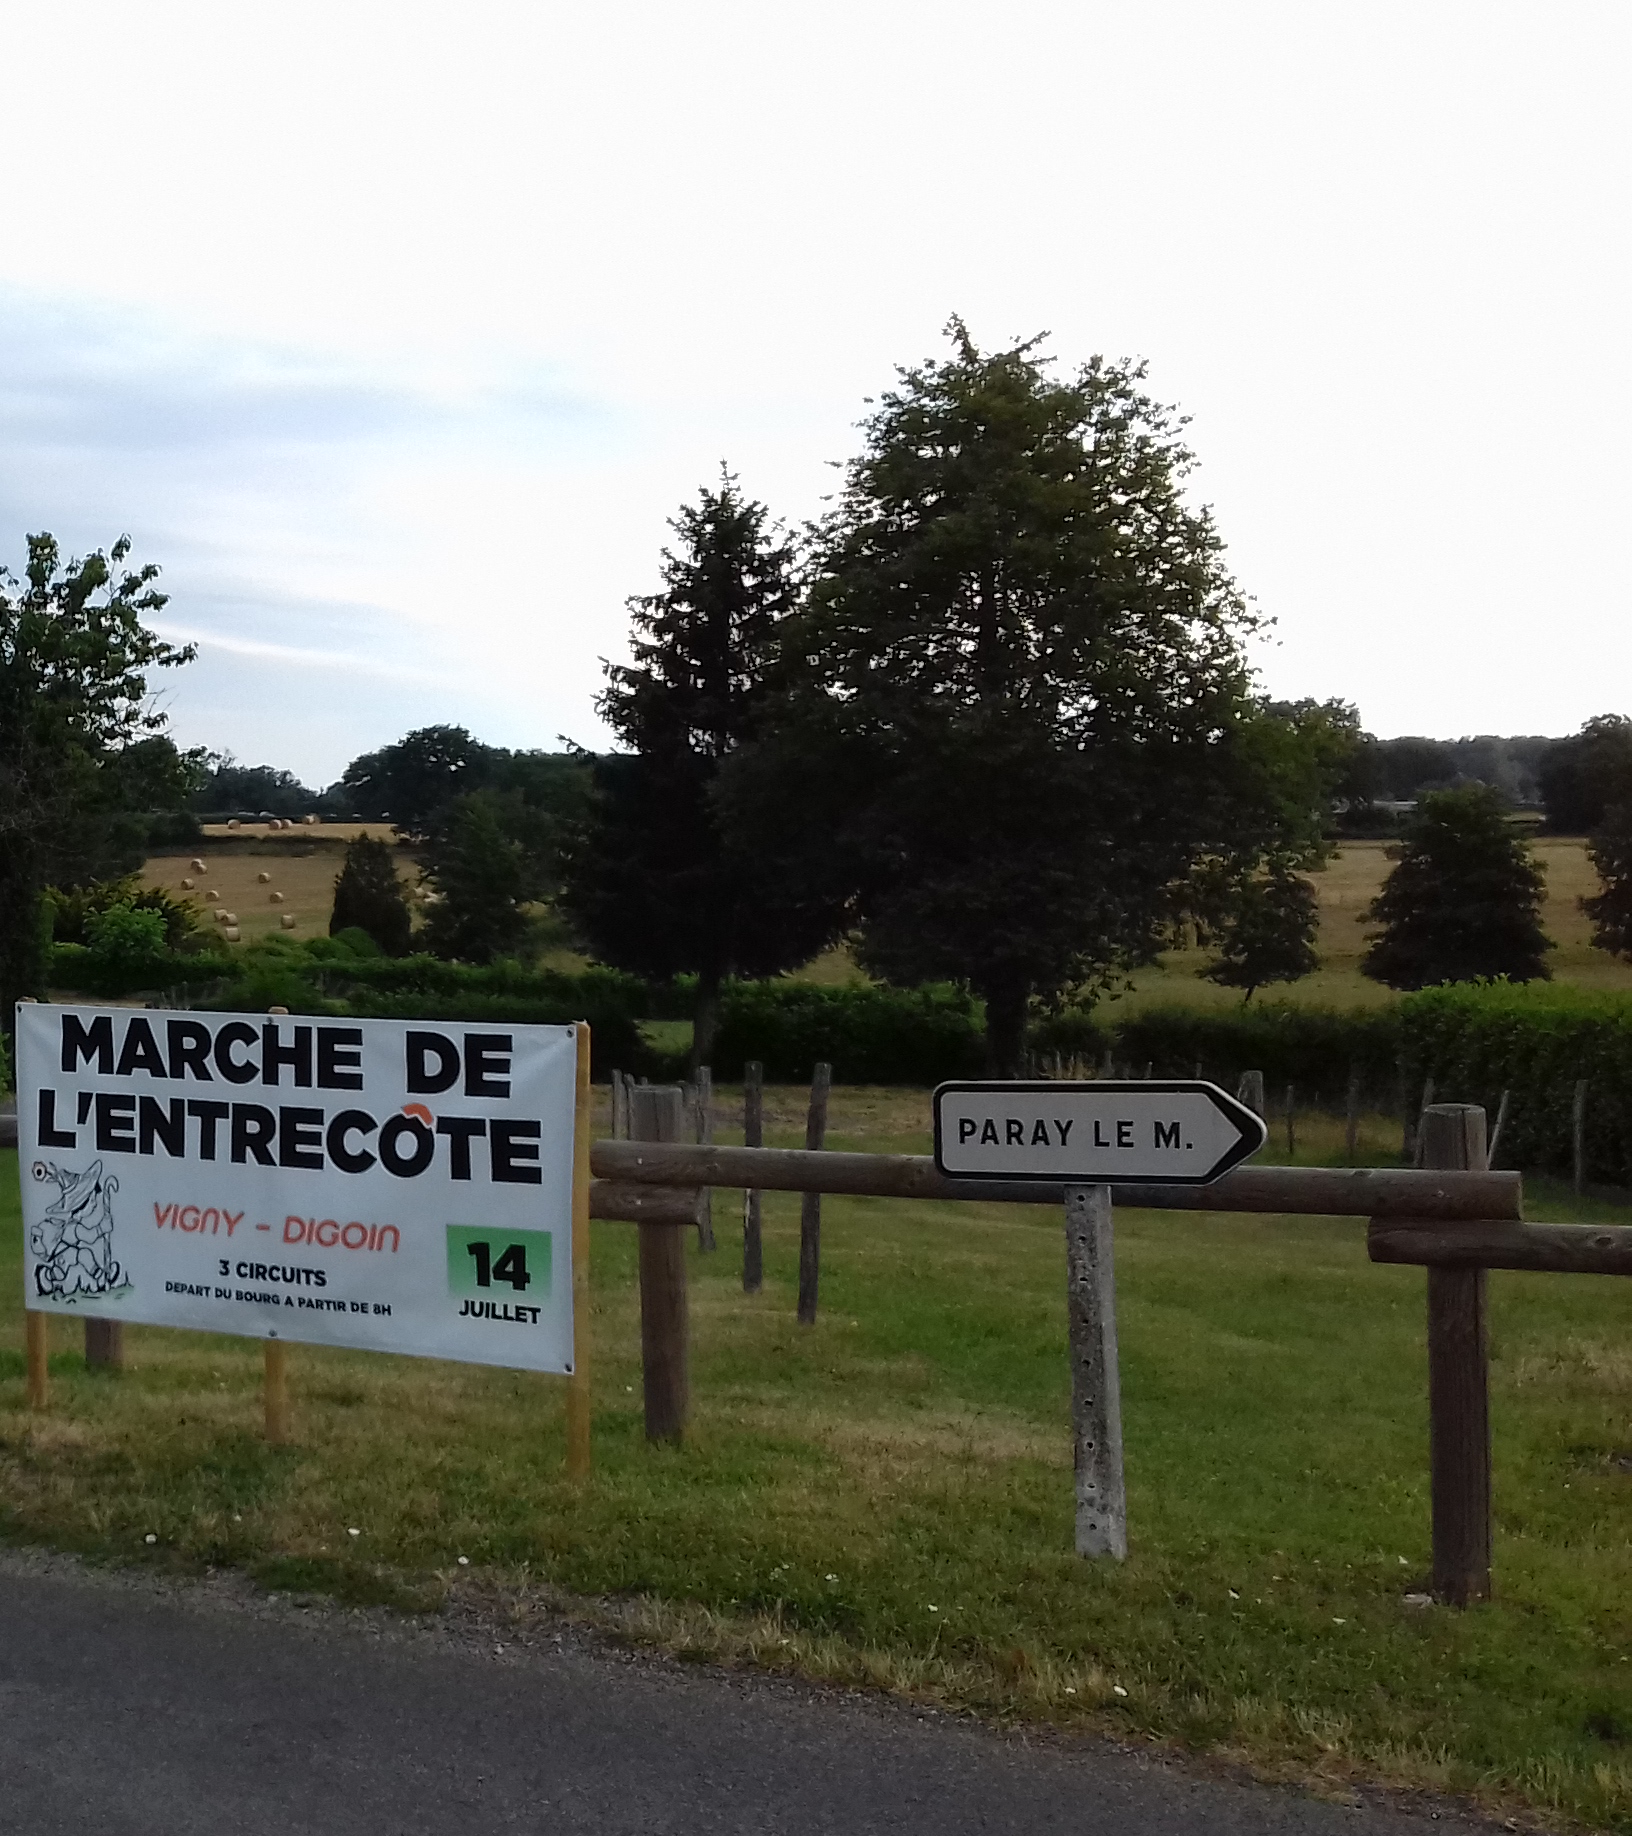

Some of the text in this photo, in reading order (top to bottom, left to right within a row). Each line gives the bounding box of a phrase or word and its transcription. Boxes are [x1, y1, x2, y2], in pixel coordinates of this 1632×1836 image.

[61, 1013, 513, 1099] MARCHE DE
[37, 1088, 543, 1185] L'ENTRECÔTE
[958, 1117, 1194, 1150] PARAY LE M.
[154, 1201, 245, 1238] VIGNY
[283, 1215, 401, 1254] DIGOIN
[218, 1259, 328, 1288] 3 CIRCUITS
[466, 1241, 531, 1291] 14
[165, 1280, 392, 1317] DEPART DU BOURG A PARTIR DE 8H
[458, 1299, 541, 1325] JUILLET
